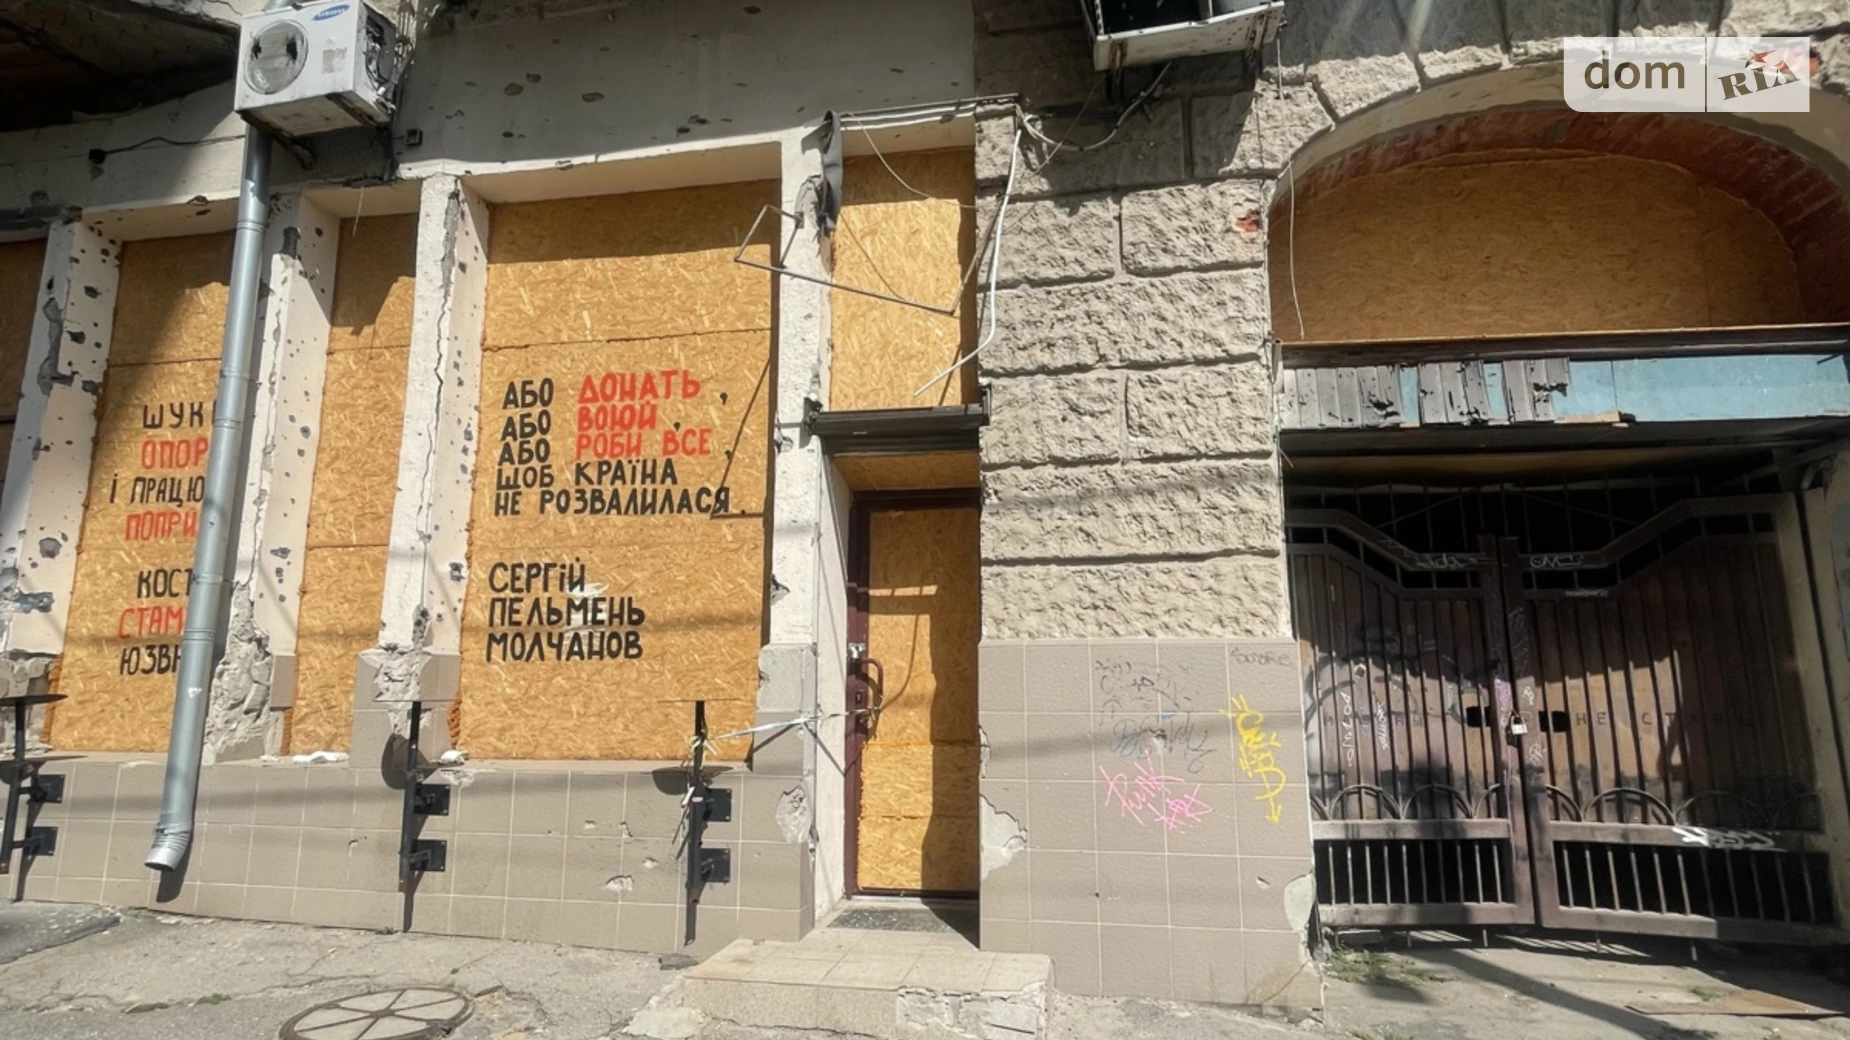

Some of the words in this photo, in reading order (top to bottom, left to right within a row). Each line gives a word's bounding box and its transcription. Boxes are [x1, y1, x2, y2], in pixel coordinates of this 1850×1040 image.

[503, 377, 554, 409] АБО
[578, 370, 701, 404] ДОНАТЬ
[143, 400, 216, 429] ШУК
[501, 409, 551, 442] АБО
[577, 401, 658, 432] ВОЮЙ
[497, 438, 551, 466] АБО
[574, 430, 642, 460] РОБИ
[661, 427, 712, 456] ВСЕ
[574, 458, 678, 487] КРАЇНА
[494, 490, 522, 516] НЕ
[539, 486, 730, 516] РОЗВАЛИЛАСЯ
[488, 597, 646, 628] ПЕЛЬМЕНЬ
[486, 630, 643, 663] МОЛЧАНОВ
